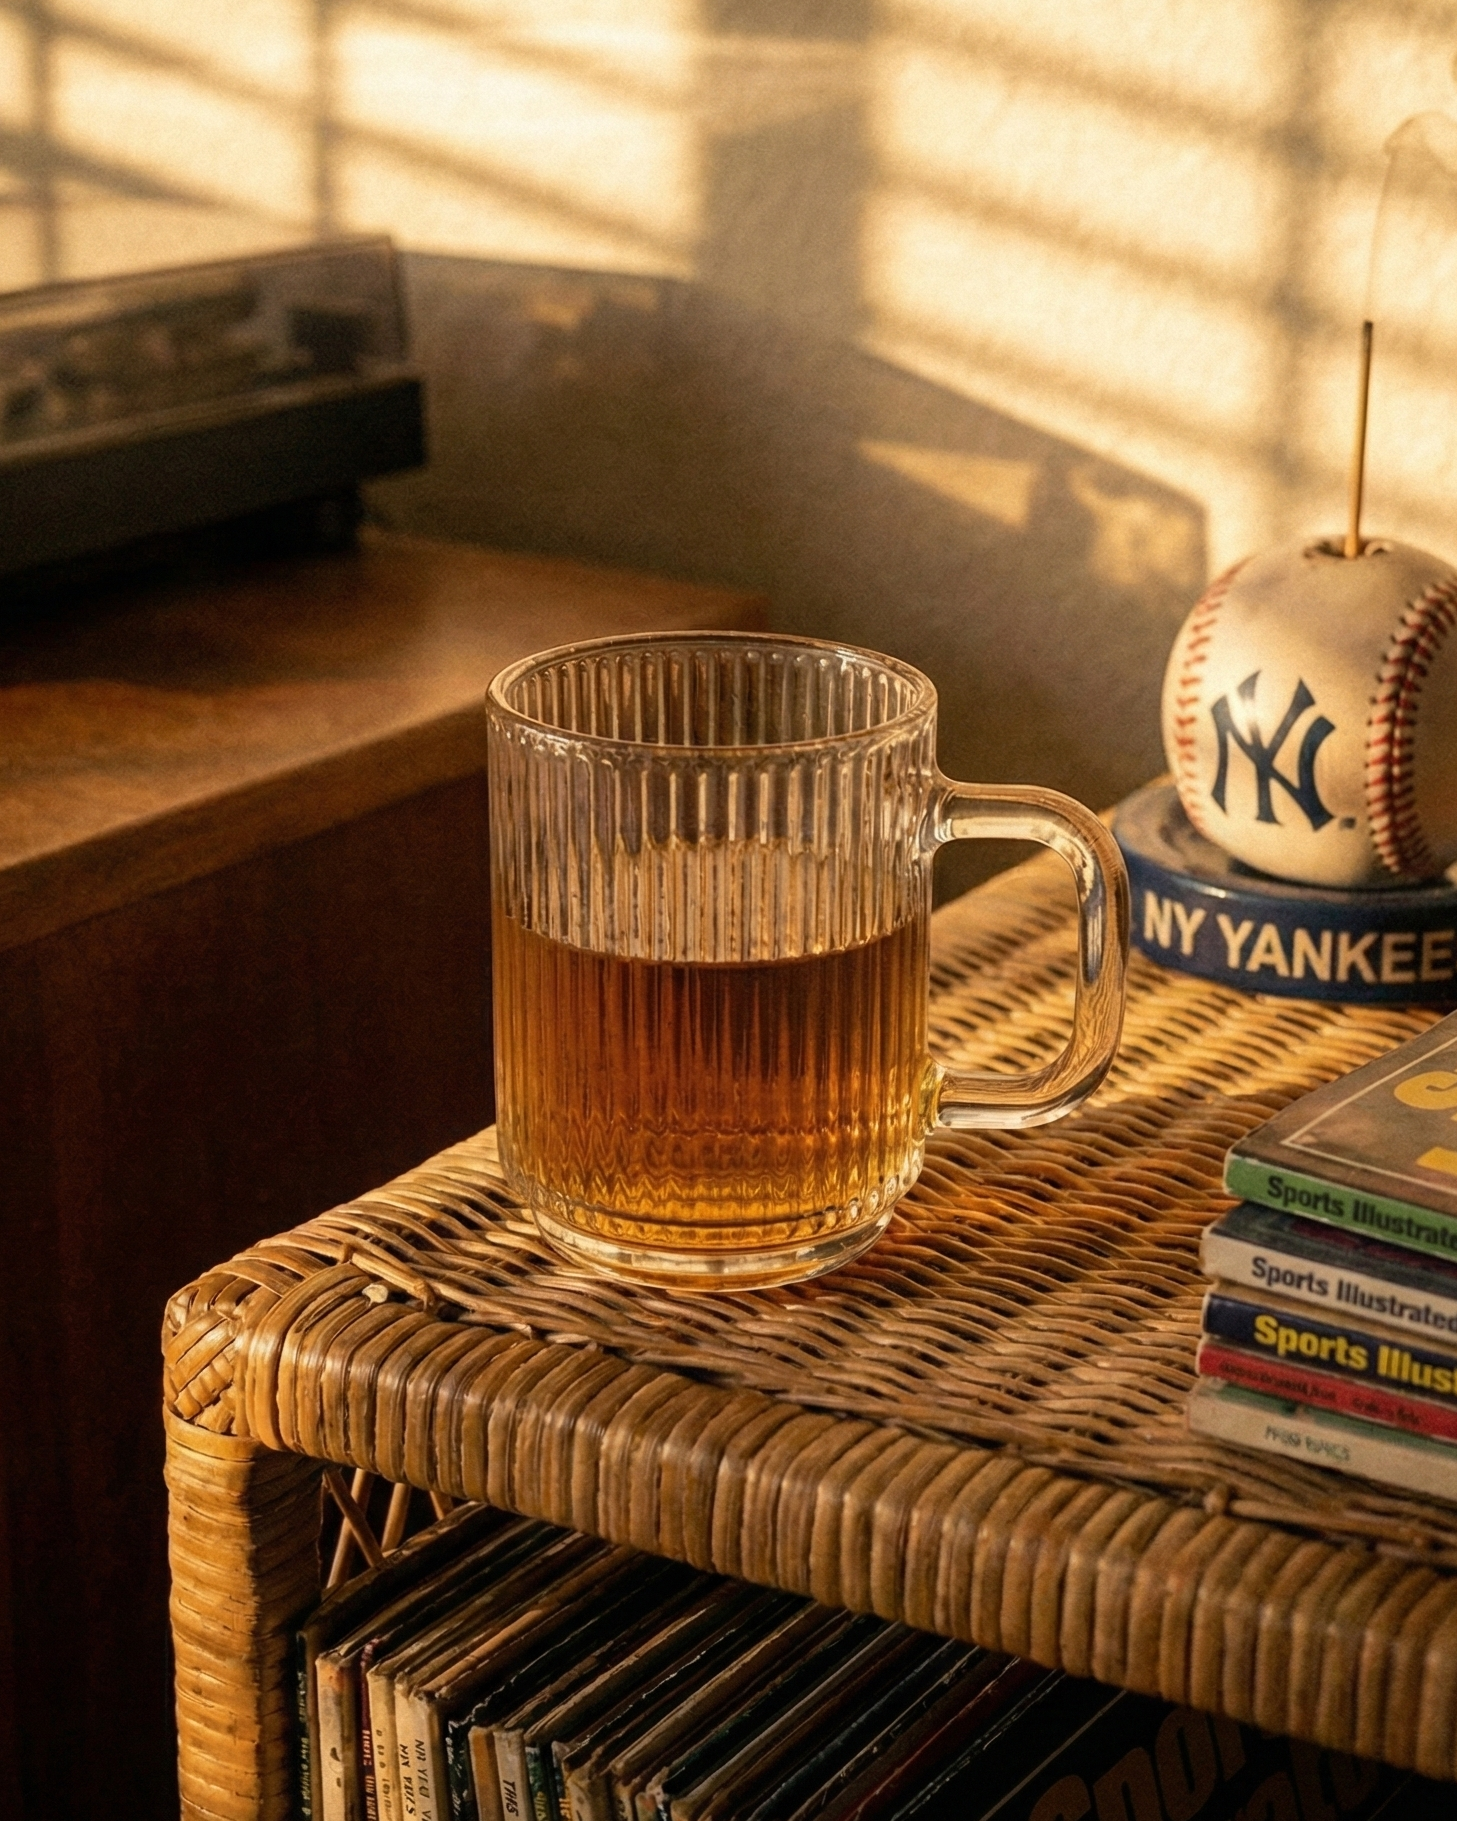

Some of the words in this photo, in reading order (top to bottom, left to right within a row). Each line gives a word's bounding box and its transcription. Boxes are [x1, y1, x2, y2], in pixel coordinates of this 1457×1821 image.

[1210, 670, 1337, 832] NY
[1143, 890, 1206, 956] NY
[1216, 913, 1456, 984] YANKEE
[1266, 1175, 1345, 1218] Sports
[1251, 1256, 1329, 1297] Sports
[1254, 1314, 1369, 1371] Sports
